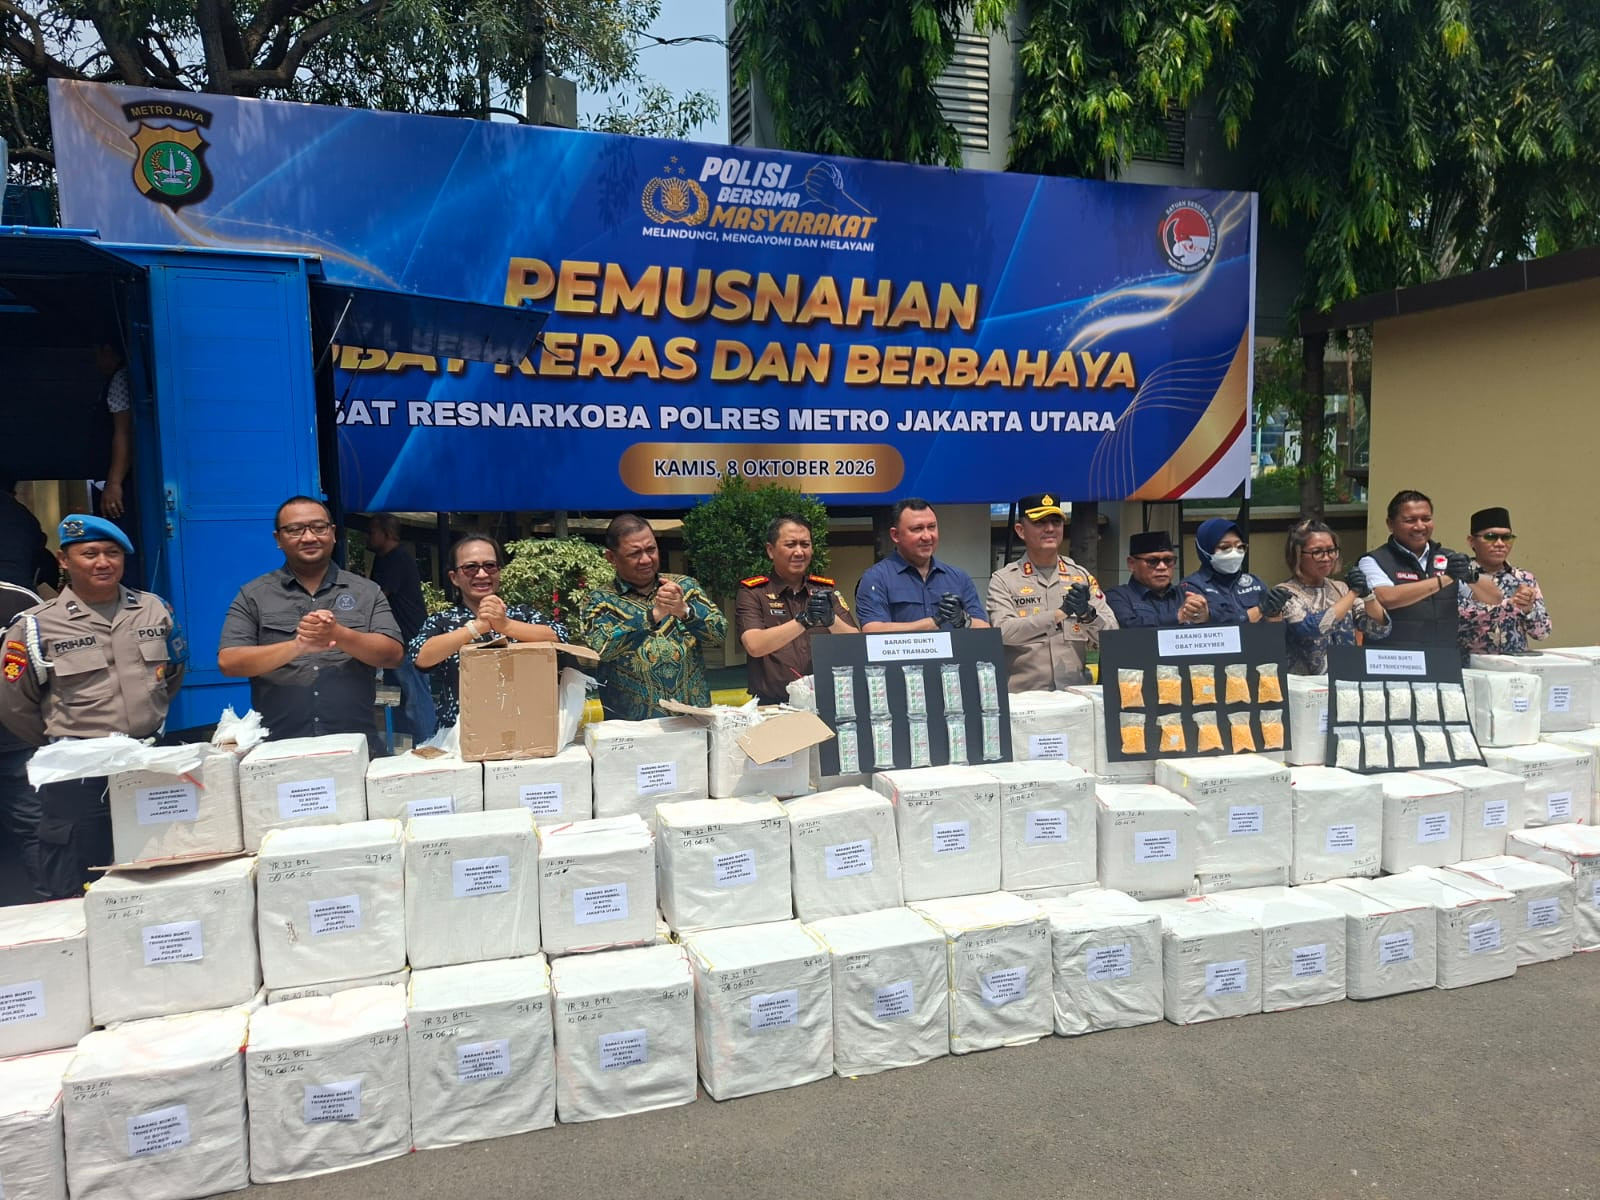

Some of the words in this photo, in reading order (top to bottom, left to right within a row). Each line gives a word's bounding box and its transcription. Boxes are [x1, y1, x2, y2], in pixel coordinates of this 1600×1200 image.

[130, 105, 173, 117] METRO
[176, 109, 204, 123] JAYA
[700, 156, 792, 189] POLISI
[717, 186, 801, 208] BERSAMA
[709, 205, 878, 239] MASYARAKAT
[642, 227, 720, 243] MELINDUNGI,
[722, 233, 791, 247] MENGAYOMI
[794, 237, 818, 248] DAN
[820, 239, 874, 252] MELAYANI
[503, 257, 979, 331] PEMUSNAHAN
[710, 339, 832, 384] DAN
[843, 344, 1137, 388] BERBAHAYA
[407, 401, 651, 430] RESNARKOBA
[659, 405, 780, 431] POLRES
[788, 408, 890, 432] METRO
[897, 410, 1023, 433] JAKARTA
[1030, 411, 1117, 433] UTARA
[653, 460, 721, 478] KAMIS,
[727, 460, 738, 476] 8
[743, 459, 830, 476] OKTOBER
[834, 459, 876, 476] 2026
[1014, 596, 1041, 605] YONKY
[54, 635, 96, 653] PRIHADI
